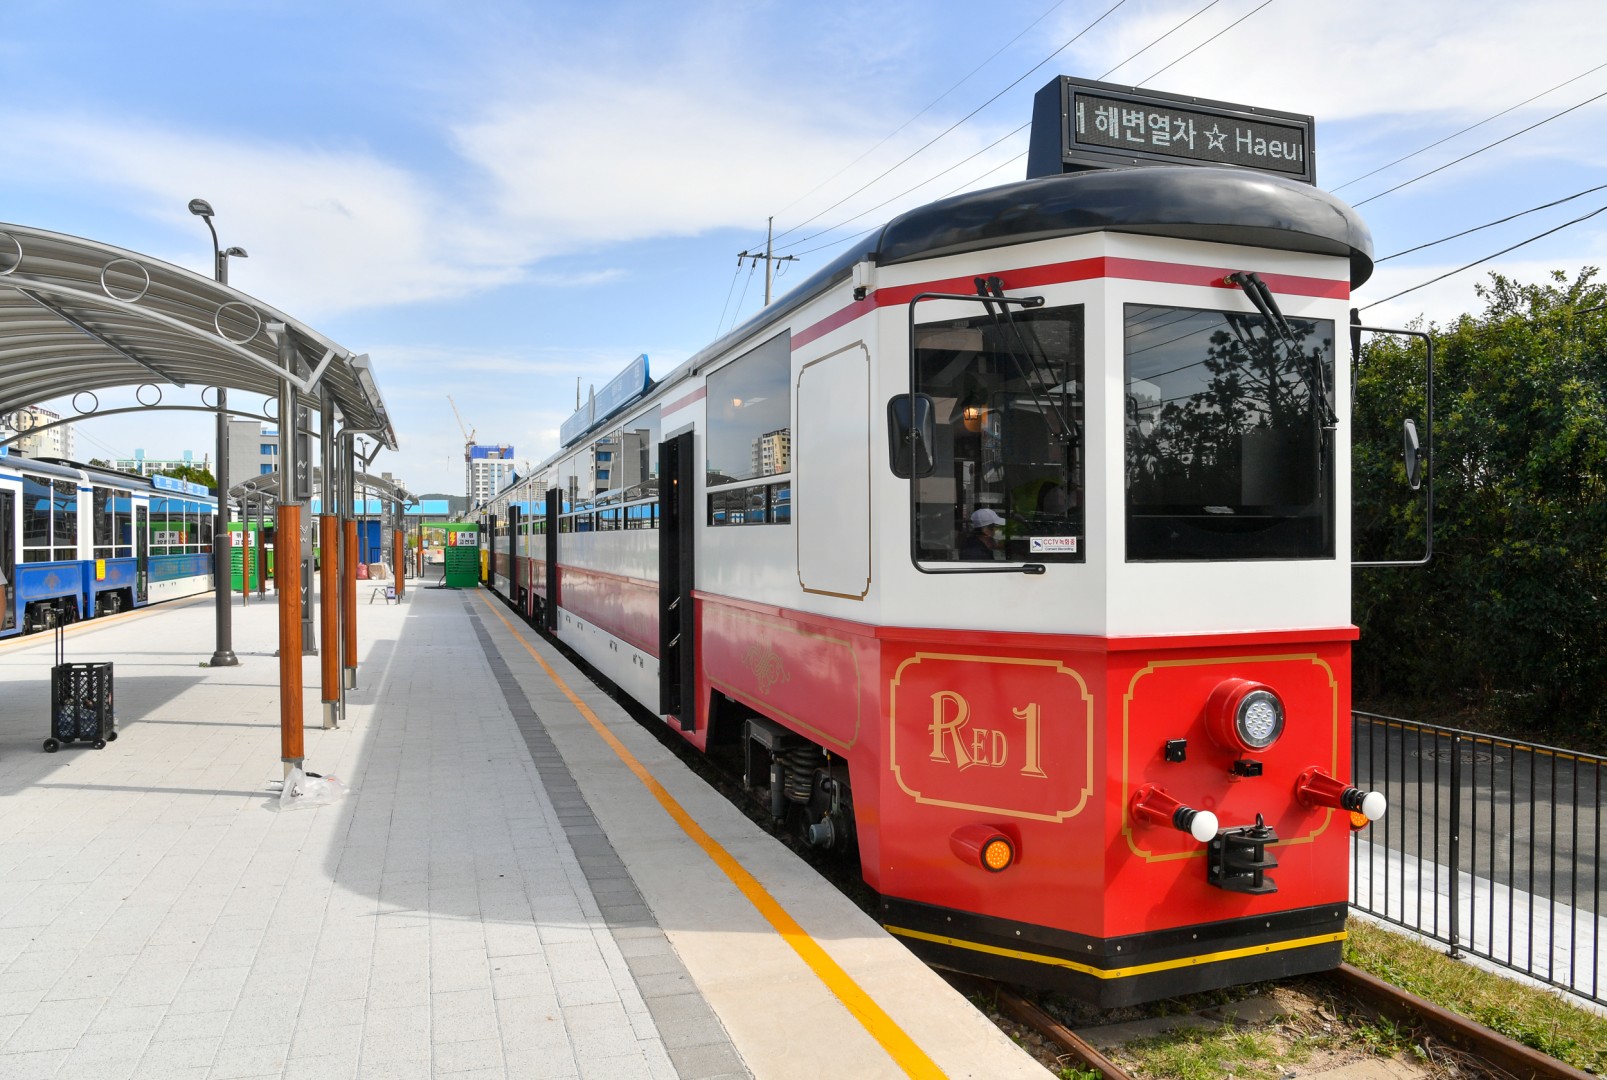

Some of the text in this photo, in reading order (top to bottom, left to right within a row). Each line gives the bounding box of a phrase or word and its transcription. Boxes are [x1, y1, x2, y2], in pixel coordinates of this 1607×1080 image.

[1094, 104, 1197, 150] 해변열차
[1235, 127, 1303, 162] Haeu
[1012, 702, 1048, 778] 1
